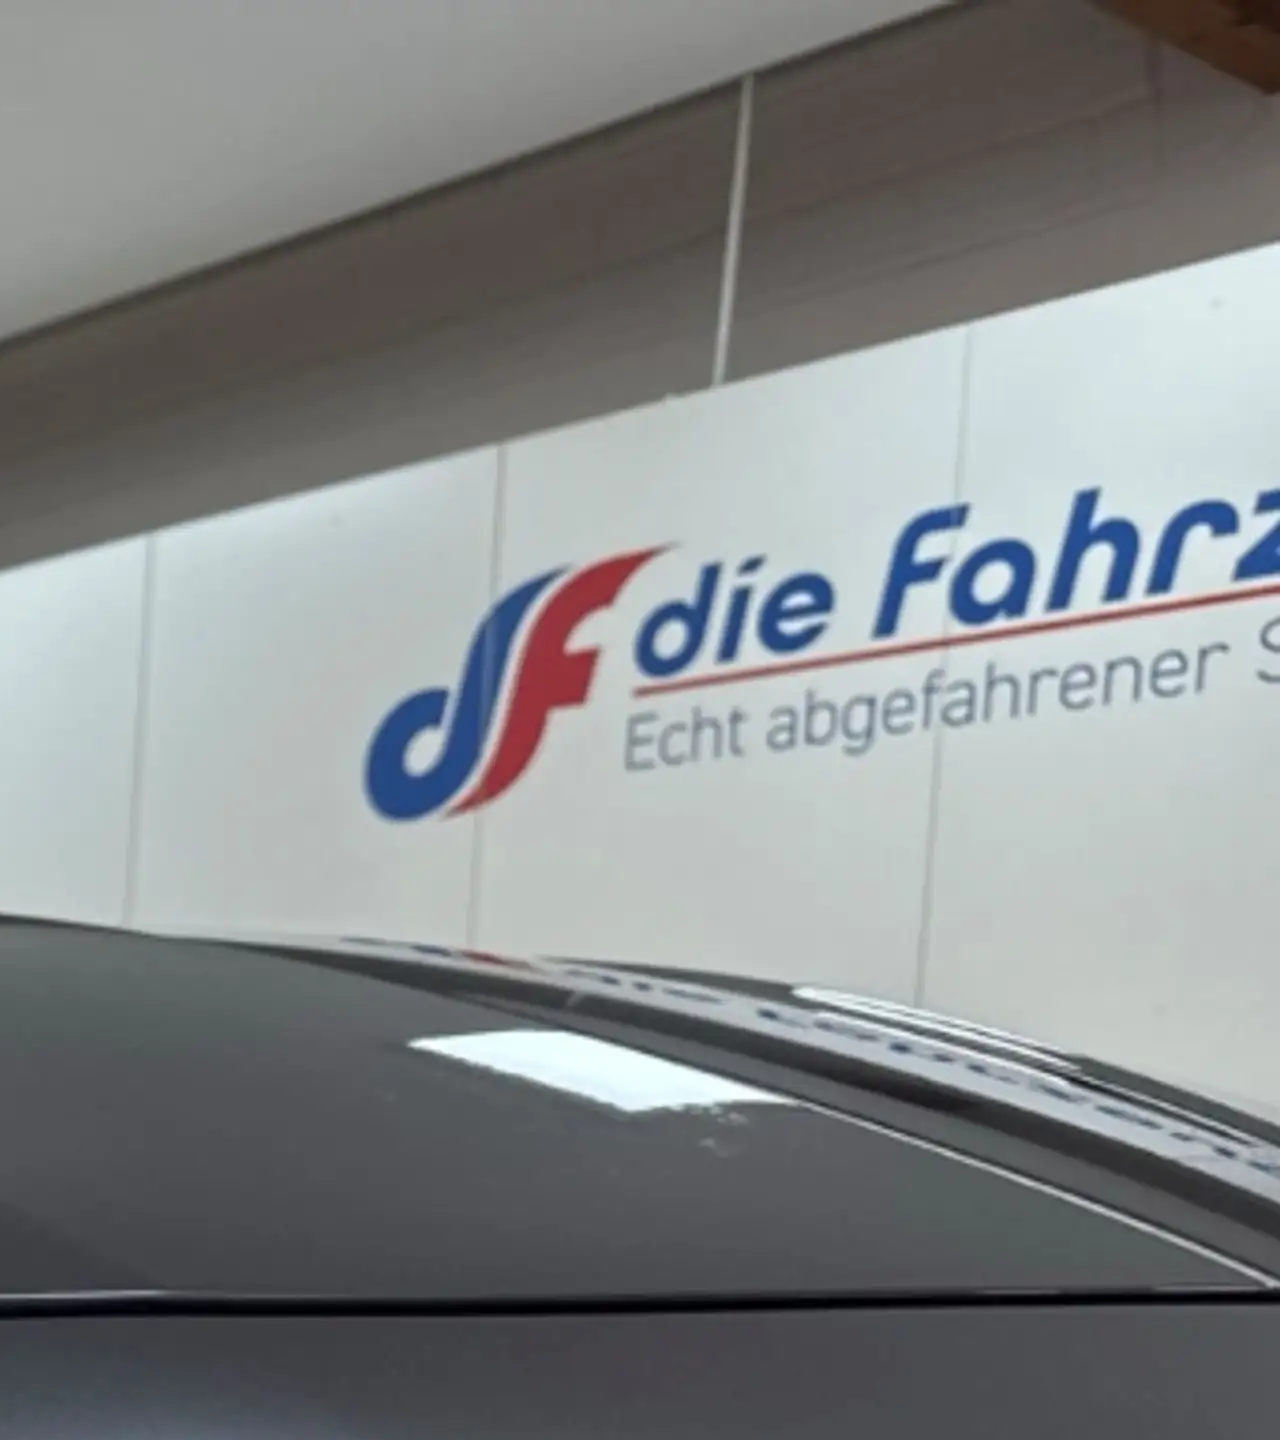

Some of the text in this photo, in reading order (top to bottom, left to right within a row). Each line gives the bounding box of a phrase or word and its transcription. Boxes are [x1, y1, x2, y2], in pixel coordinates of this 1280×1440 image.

[634, 554, 836, 679] die
[623, 706, 748, 773] Echt
[766, 640, 1231, 757] abgefahrener
